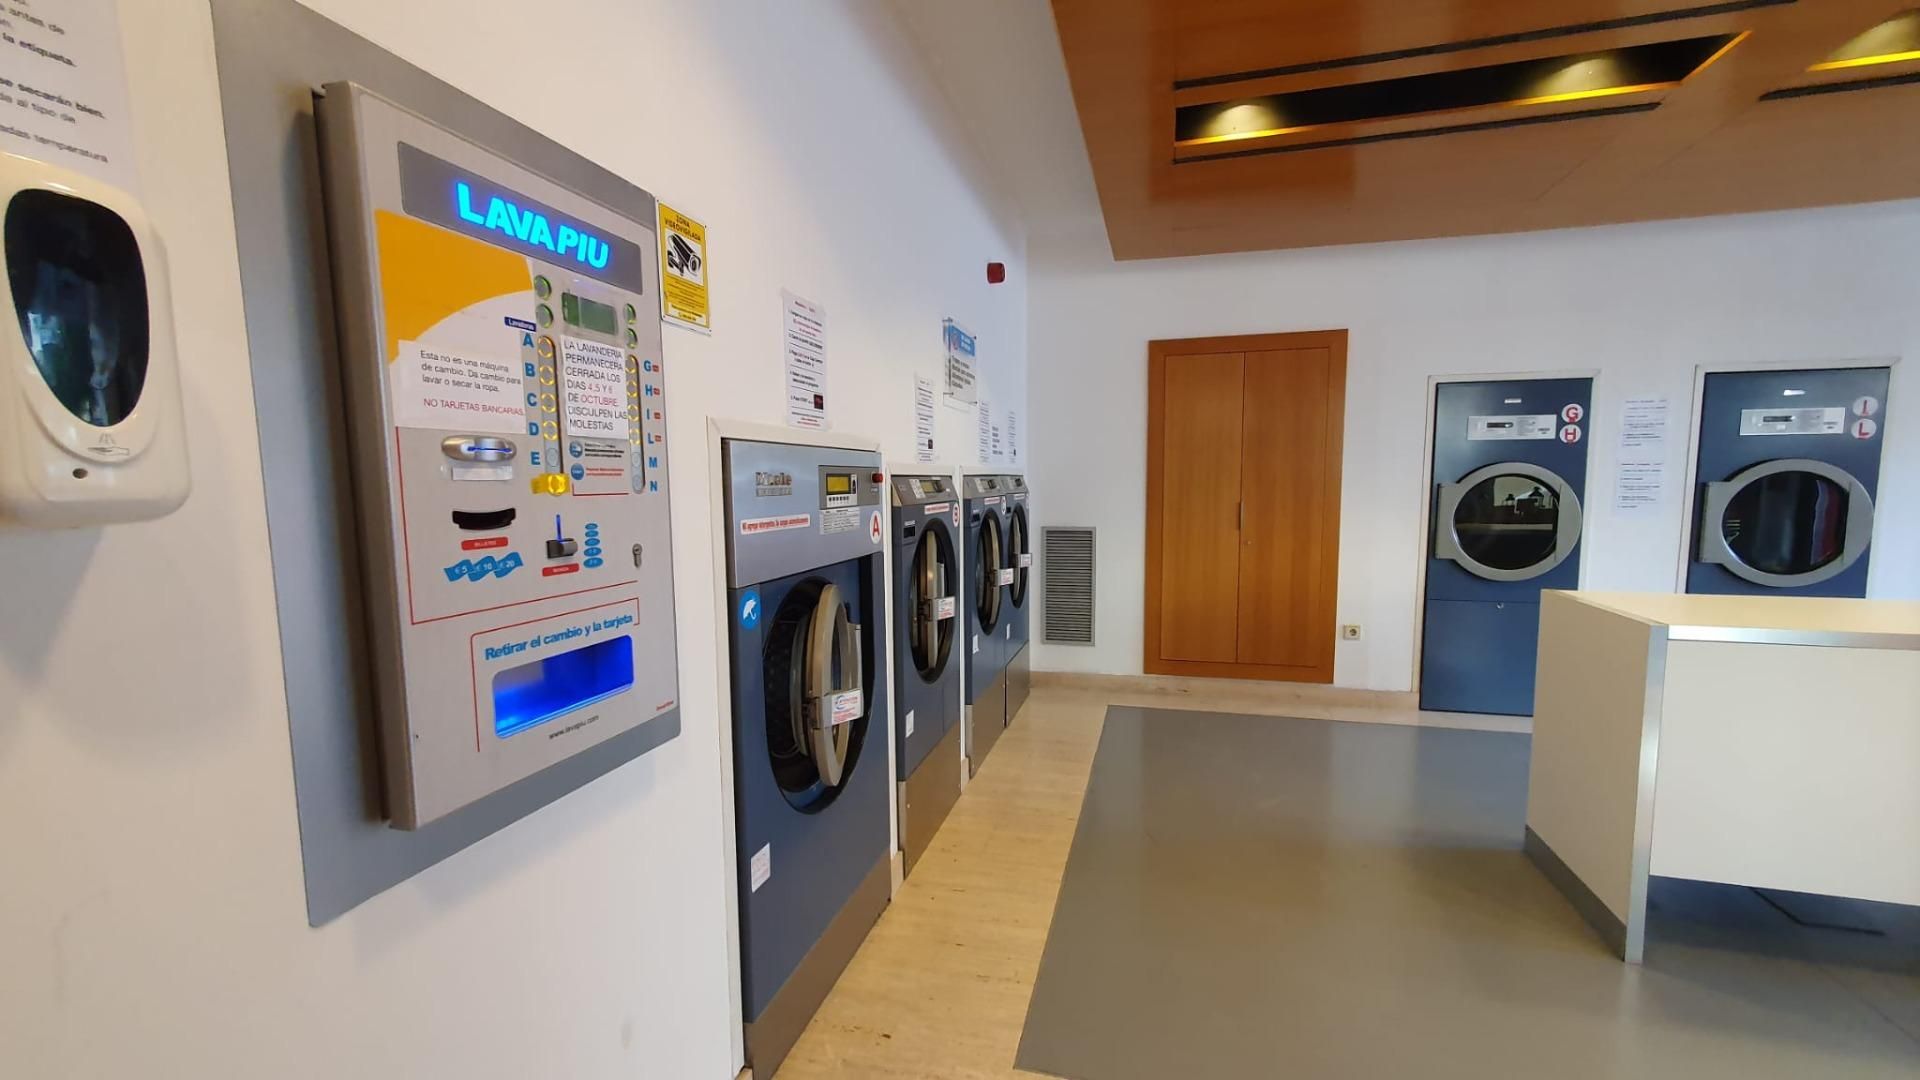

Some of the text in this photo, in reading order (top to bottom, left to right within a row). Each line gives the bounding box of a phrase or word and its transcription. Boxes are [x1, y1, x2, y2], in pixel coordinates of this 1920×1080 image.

[522, 332, 535, 348] A
[564, 340, 575, 350] LA
[420, 350, 509, 373] Esta no es una máquina
[644, 360, 652, 373] G
[421, 363, 522, 386] de cambio. Da cambio para
[525, 362, 536, 377] B
[565, 366, 621, 384] CERRADA LOS
[422, 374, 442, 385] lavar
[452, 379, 473, 389] secar
[475, 382, 481, 390] la
[645, 384, 653, 396] H
[424, 398, 525, 416] NO TARJETAS BANCARIAS
[527, 392, 538, 408] C
[568, 392, 620, 407] DE OCTUBRE
[568, 406, 628, 420] DISCULPEN LAS
[1566, 406, 1579, 420] G
[529, 422, 540, 436] D
[569, 418, 614, 431] MOLESTIAS
[1858, 422, 1870, 437] L
[648, 432, 655, 445] L
[1564, 428, 1577, 442] H
[530, 451, 541, 466] E
[649, 456, 658, 468] M
[650, 481, 658, 492] N
[872, 514, 881, 537] A
[484, 613, 633, 661] Retirar el cambio y la tarjeta
